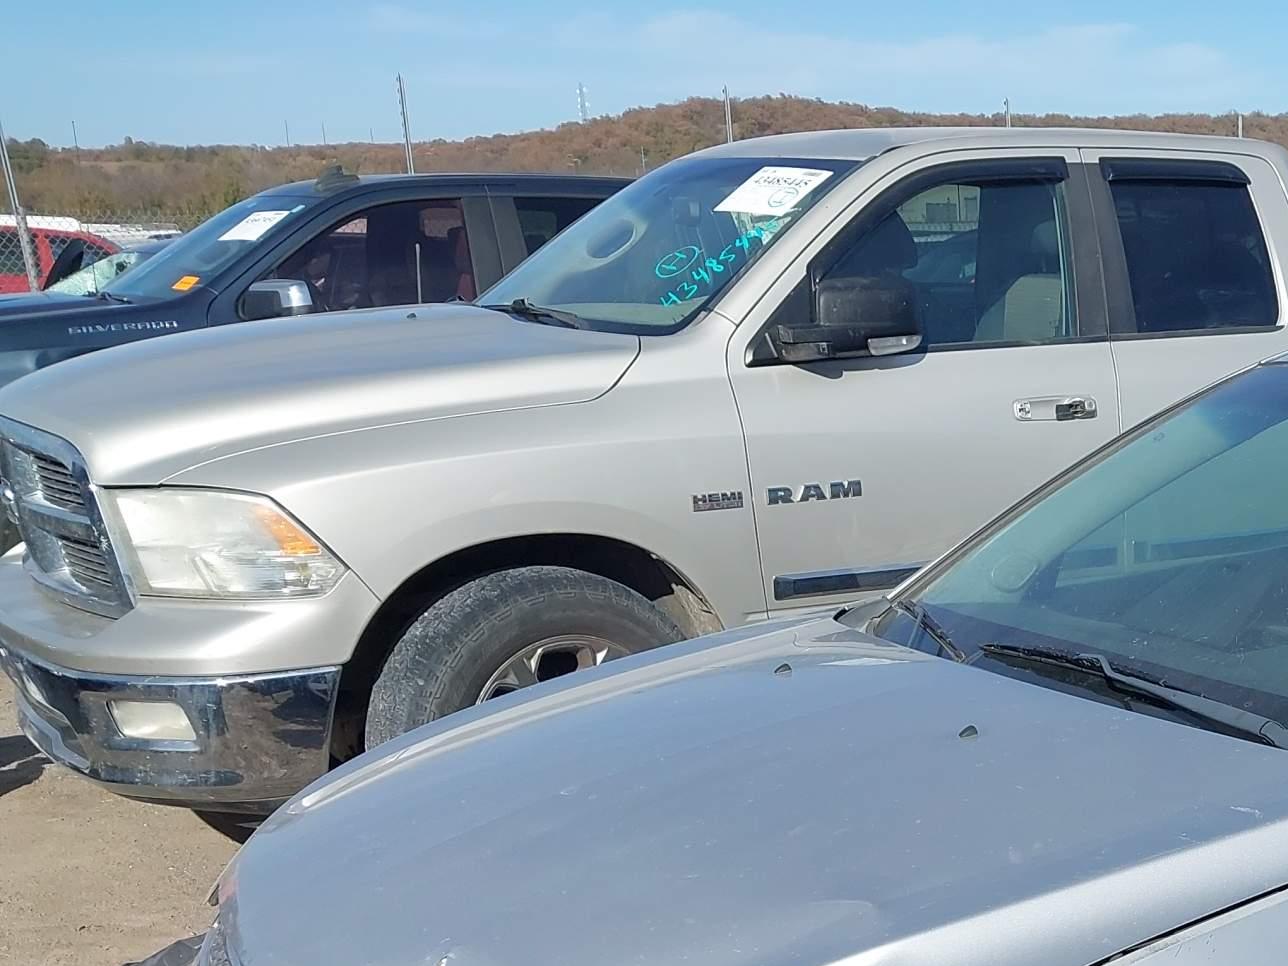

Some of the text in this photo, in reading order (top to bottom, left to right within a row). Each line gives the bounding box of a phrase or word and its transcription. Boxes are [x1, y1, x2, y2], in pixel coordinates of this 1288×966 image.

[68, 320, 178, 335] SILVERADO
[692, 491, 744, 505] HEMI
[767, 479, 863, 506] RAM
